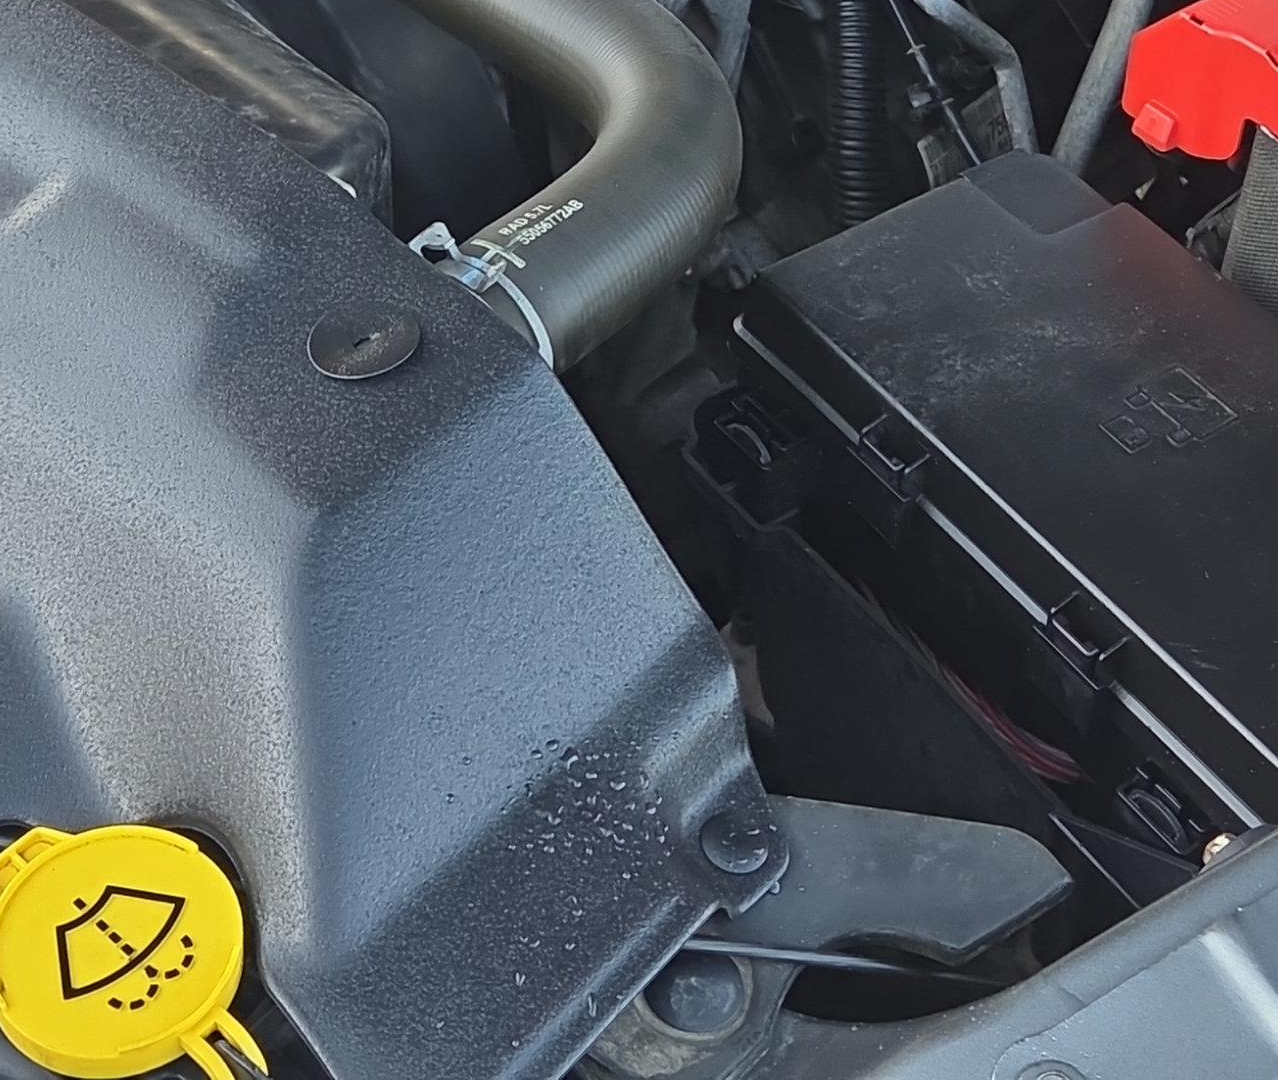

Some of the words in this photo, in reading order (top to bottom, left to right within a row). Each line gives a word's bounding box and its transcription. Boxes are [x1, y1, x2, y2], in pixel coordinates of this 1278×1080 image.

[498, 216, 529, 236] RAD
[527, 203, 554, 221] 5.7L
[518, 199, 585, 245] 55056772AB
